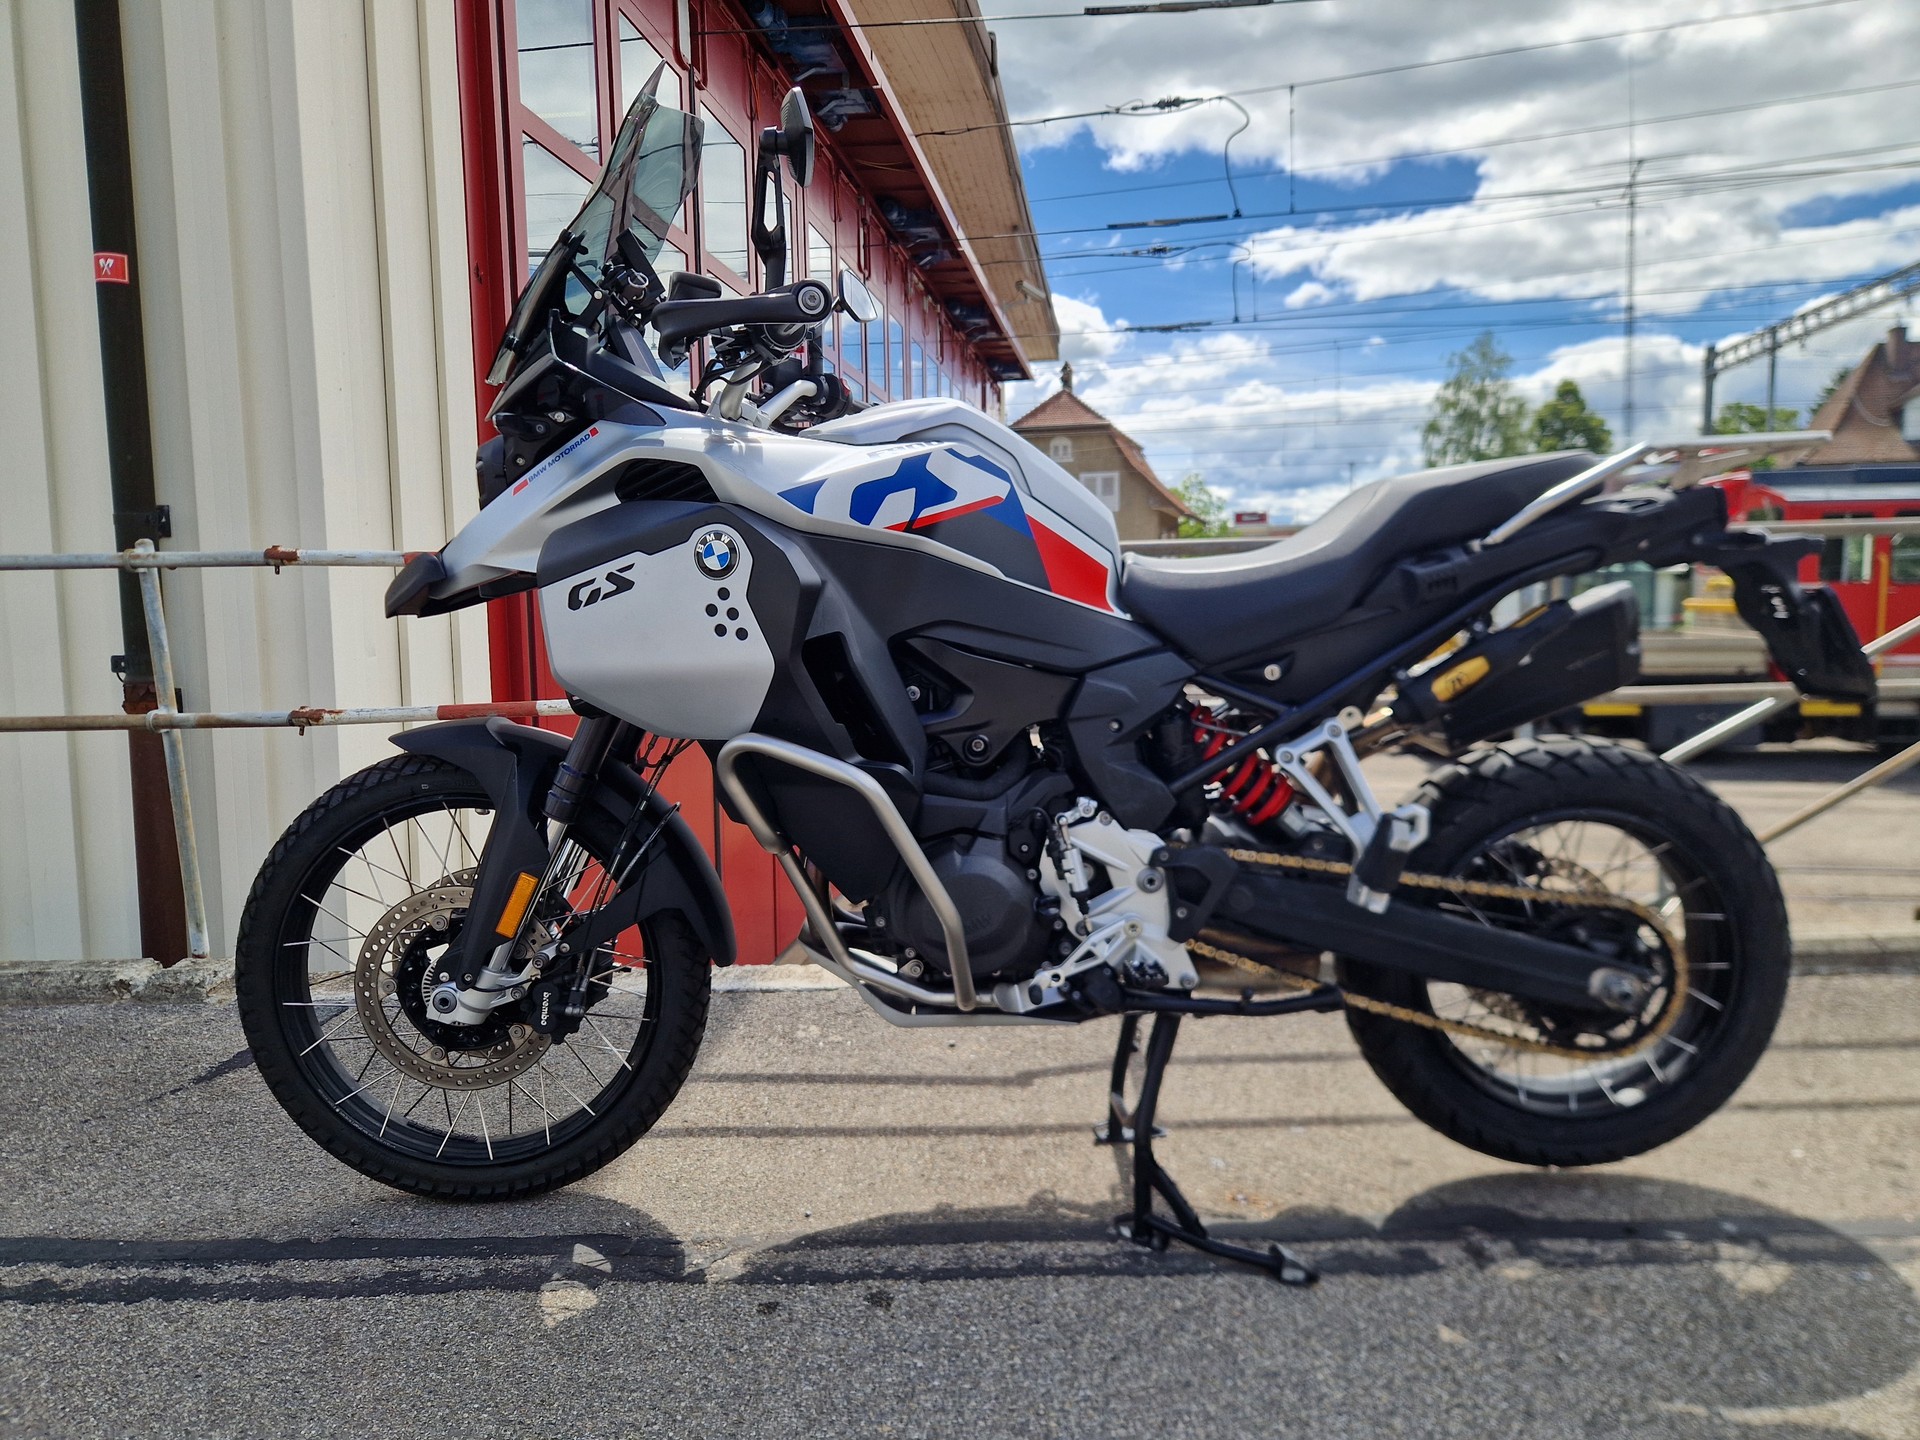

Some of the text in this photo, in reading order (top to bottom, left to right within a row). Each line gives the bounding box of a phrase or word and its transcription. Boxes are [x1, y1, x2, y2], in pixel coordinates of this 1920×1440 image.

[528, 433, 591, 483] BMW MOTORRAD
[696, 532, 731, 553] BMW
[567, 562, 636, 612] GS
[540, 991, 552, 1026] brembo
